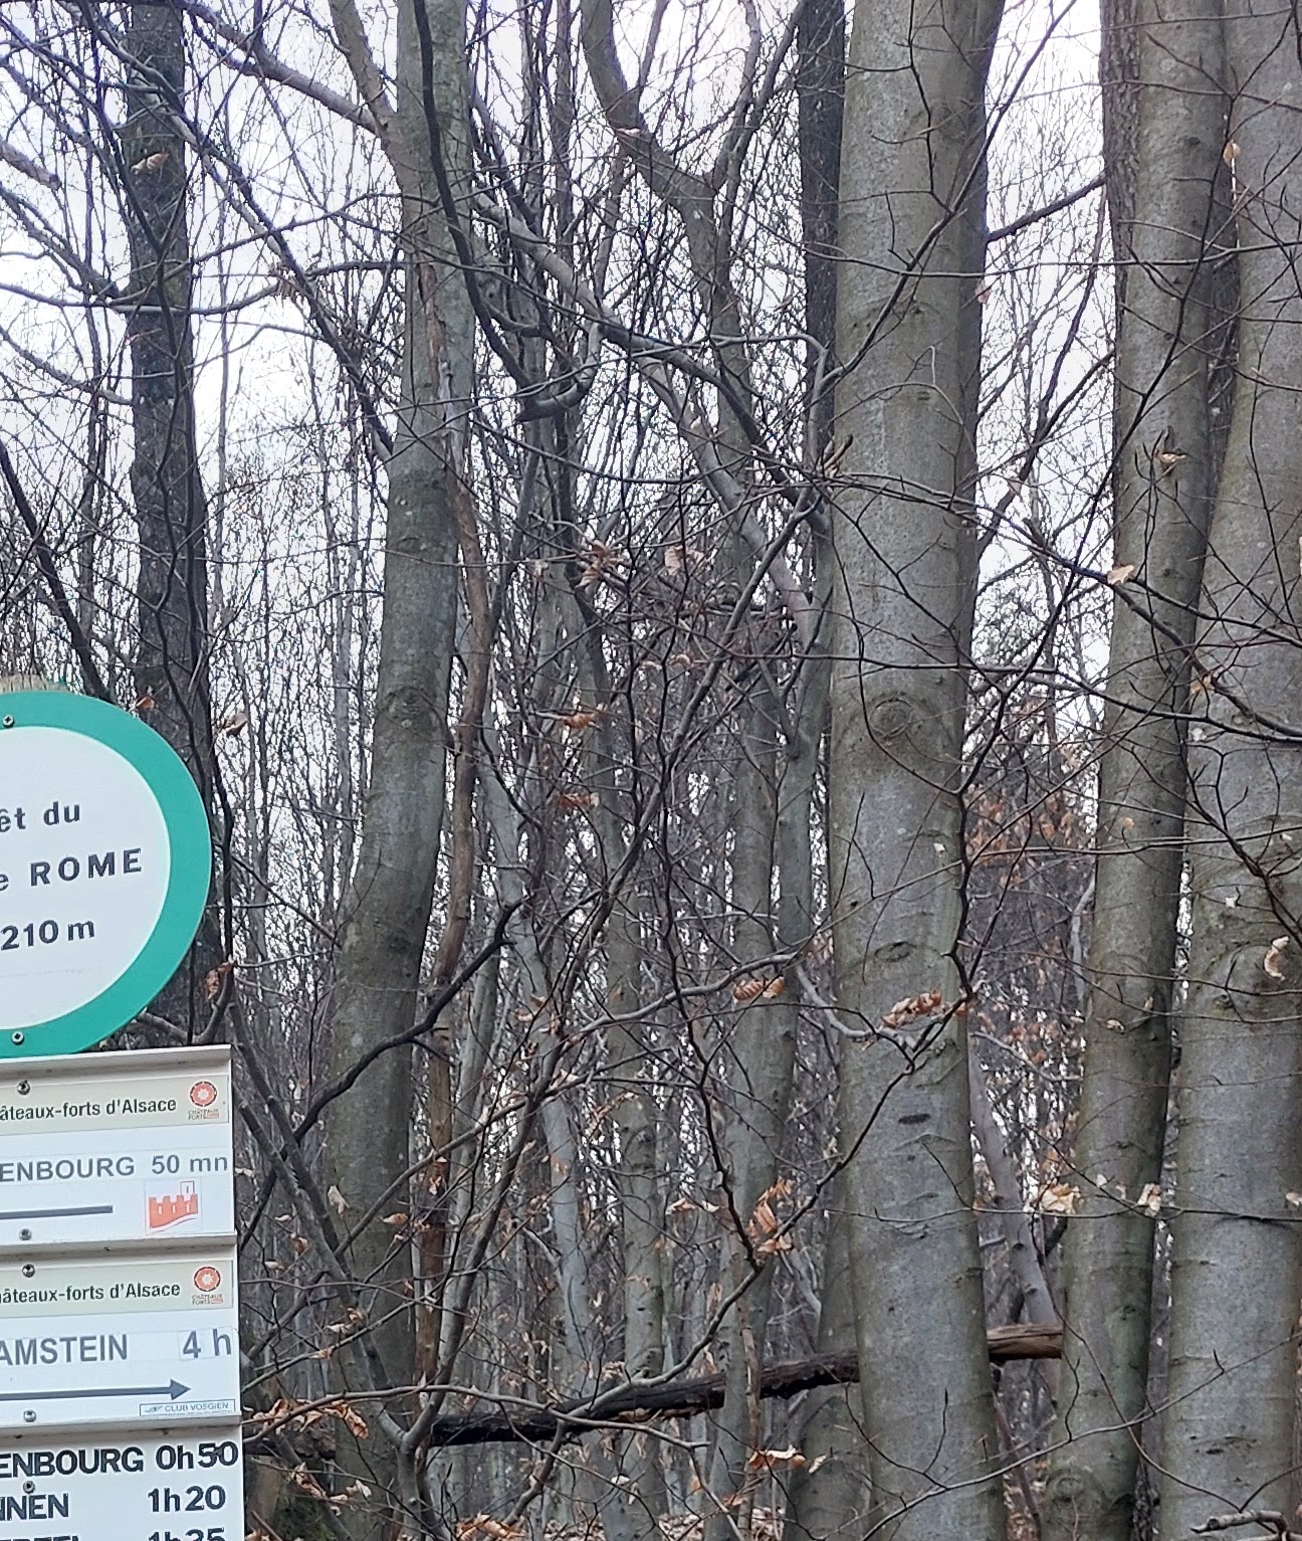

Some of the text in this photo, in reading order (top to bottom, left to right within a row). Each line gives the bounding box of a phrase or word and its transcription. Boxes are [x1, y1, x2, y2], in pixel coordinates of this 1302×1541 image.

[43, 801, 81, 826] du
[30, 848, 143, 887] ROME
[105, 1097, 177, 1117] d'Alsace
[151, 1154, 180, 1175] 50
[189, 1155, 229, 1173] mn
[109, 1280, 181, 1301] d'Alsace
[182, 1330, 201, 1359] 4
[213, 1327, 233, 1357] h
